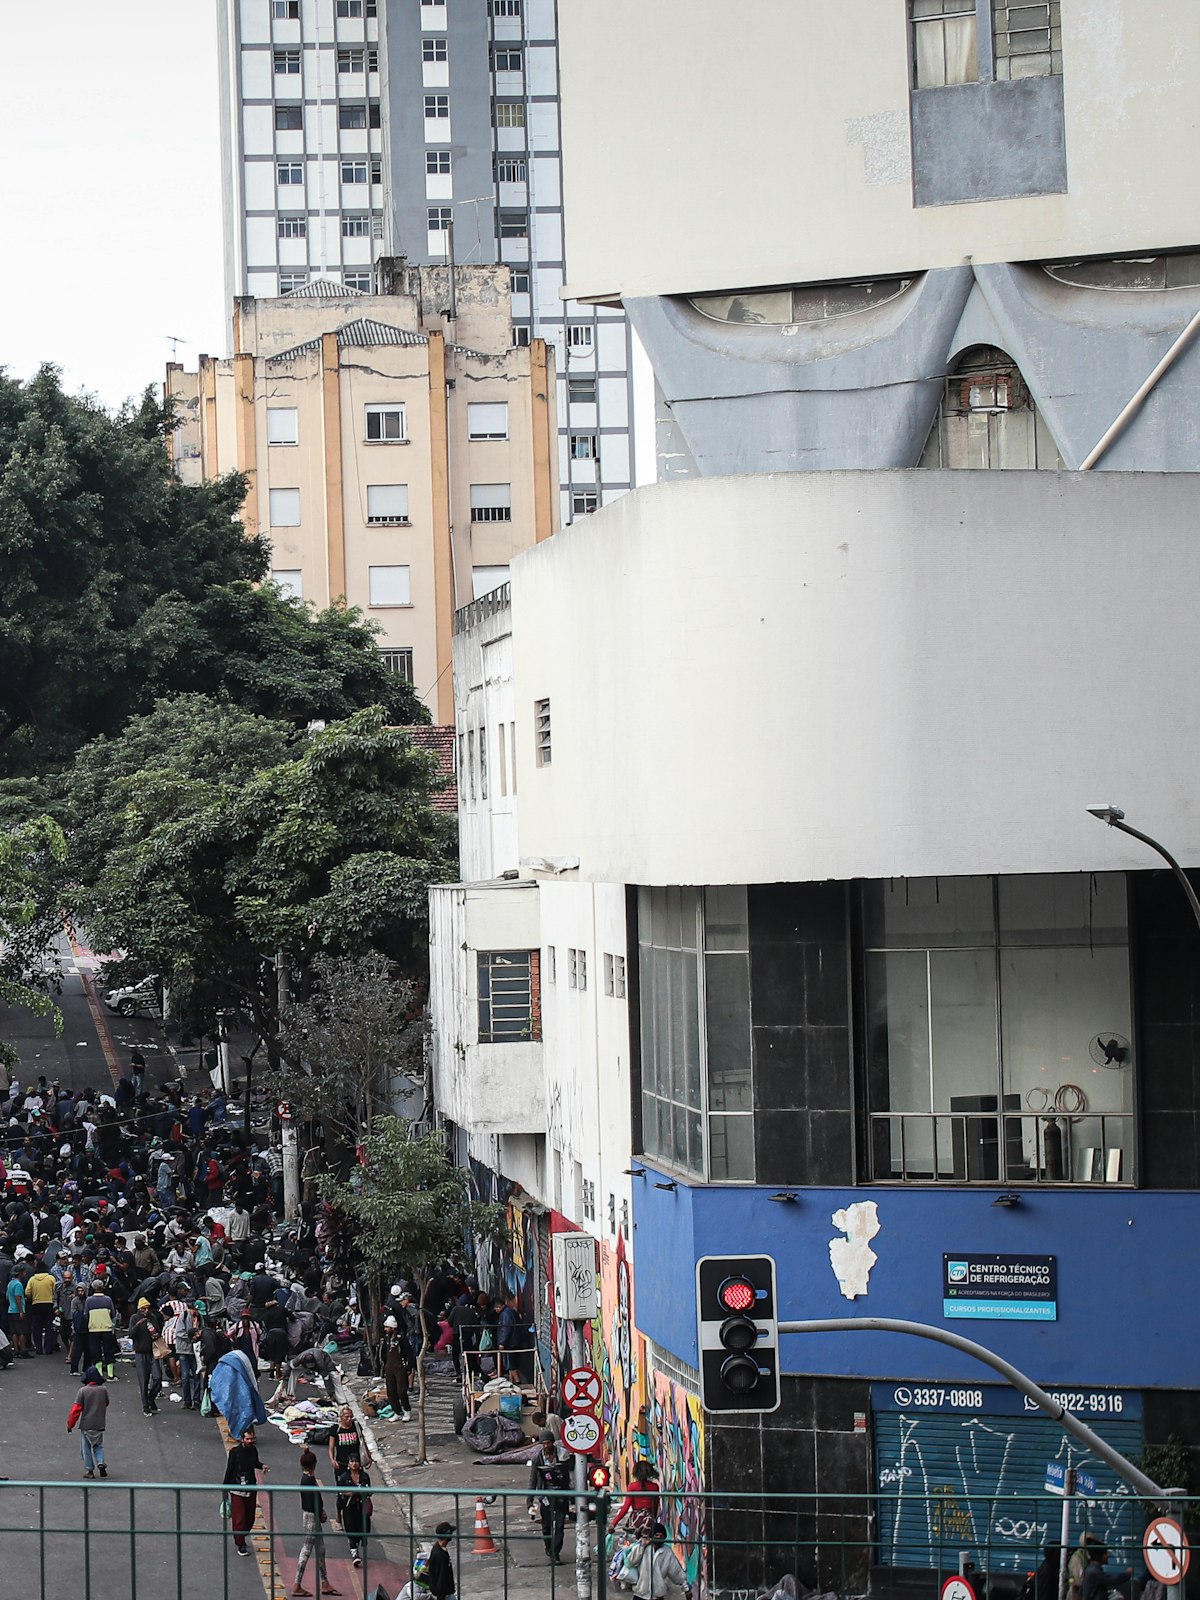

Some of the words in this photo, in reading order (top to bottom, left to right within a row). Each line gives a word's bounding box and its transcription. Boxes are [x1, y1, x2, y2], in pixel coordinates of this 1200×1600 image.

[970, 1264, 1007, 1273] CENTRO
[1009, 1263, 1049, 1274] TÉCNICO
[970, 1275, 982, 1283] DE
[984, 1274, 1050, 1285] REFRIGERAÇÃO
[950, 1305, 976, 1313] CURSOS
[977, 1306, 1051, 1314] PROFISSIONALIZANTES
[914, 1388, 982, 1408] 3337-0808
[1048, 1393, 1123, 1412] 6922-9316
